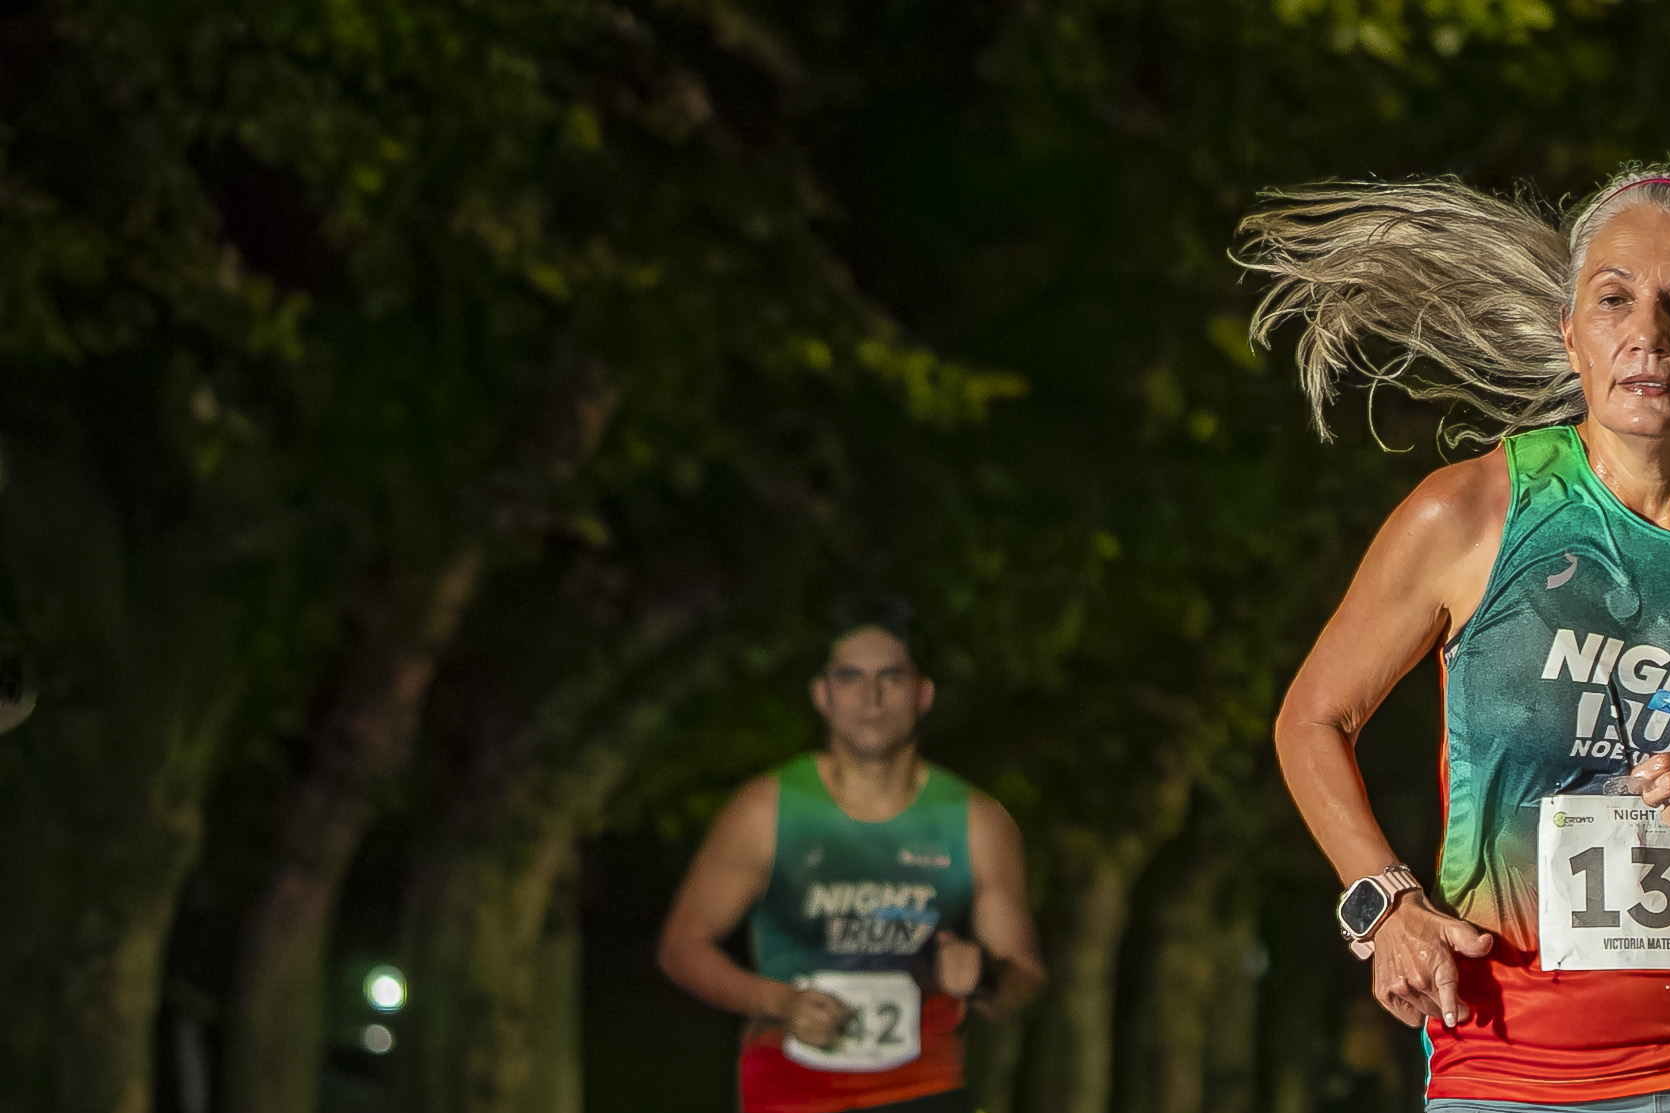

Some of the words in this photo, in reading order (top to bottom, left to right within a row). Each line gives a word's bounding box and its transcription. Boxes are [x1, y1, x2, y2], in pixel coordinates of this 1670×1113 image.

[1614, 809, 1657, 821] NIGHT
[804, 881, 937, 918] NIGHT
[1603, 937, 1645, 950] VICTORIA
